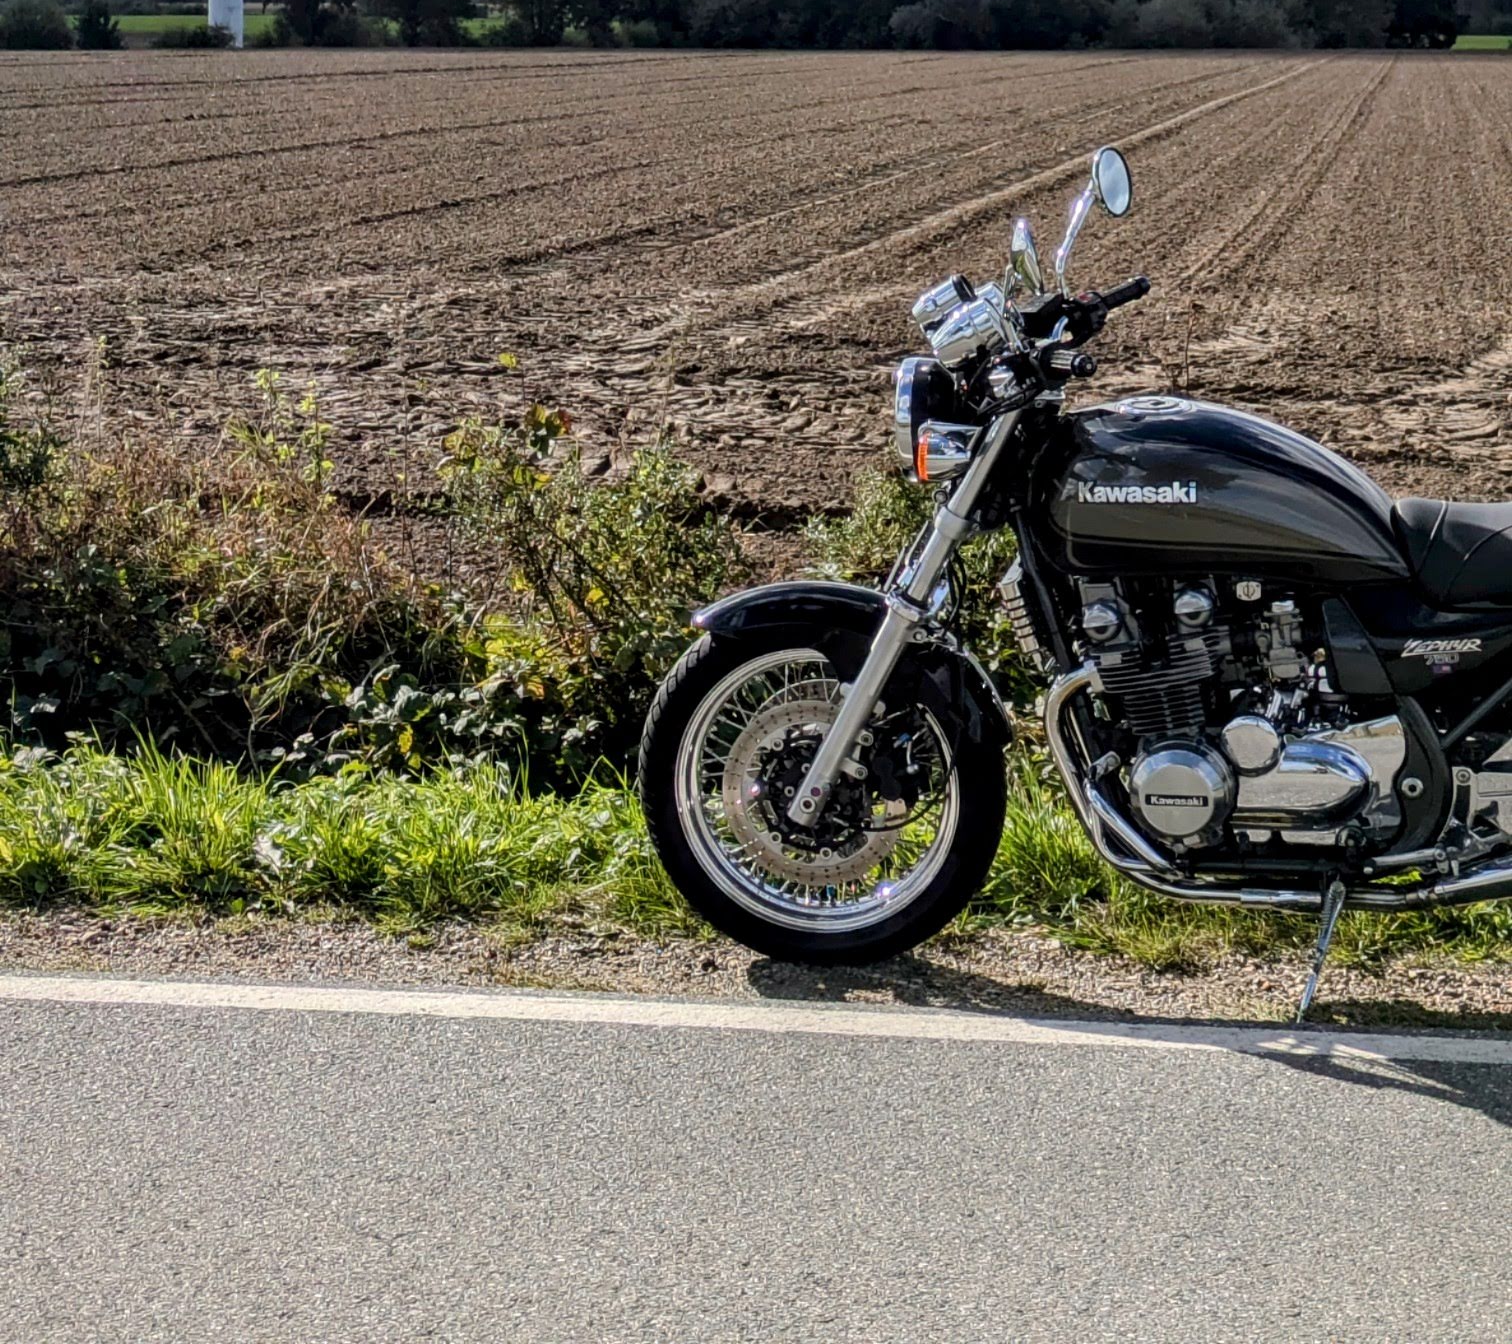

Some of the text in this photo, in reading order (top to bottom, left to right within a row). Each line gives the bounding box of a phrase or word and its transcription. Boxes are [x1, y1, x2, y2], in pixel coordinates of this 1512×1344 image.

[1078, 481, 1197, 503] Kawasaki
[1401, 638, 1482, 658] ZEPHYR
[1150, 795, 1204, 806] Kawasaki
